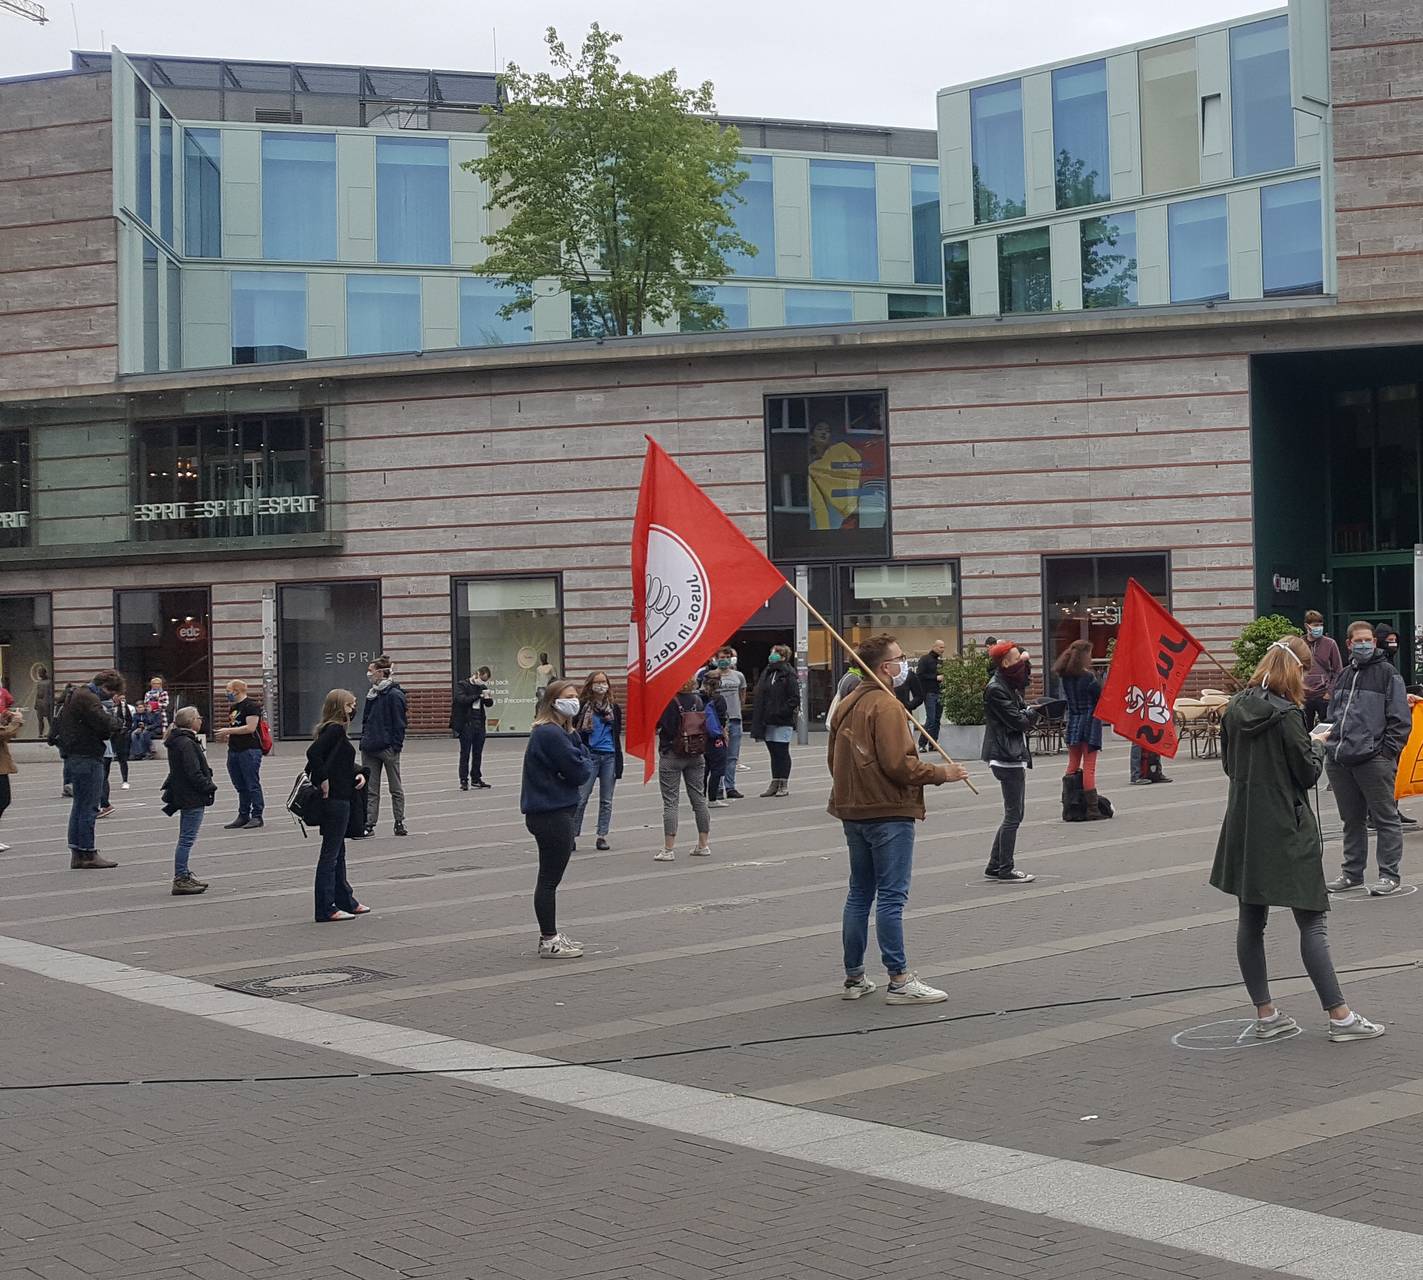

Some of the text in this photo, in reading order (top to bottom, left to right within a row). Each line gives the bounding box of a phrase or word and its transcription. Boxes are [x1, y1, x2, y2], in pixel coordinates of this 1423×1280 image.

[134, 502, 189, 521] ESPRIT
[258, 495, 319, 515] ESPRIT
[179, 625, 200, 637] edc
[325, 651, 376, 664] ESPRI
